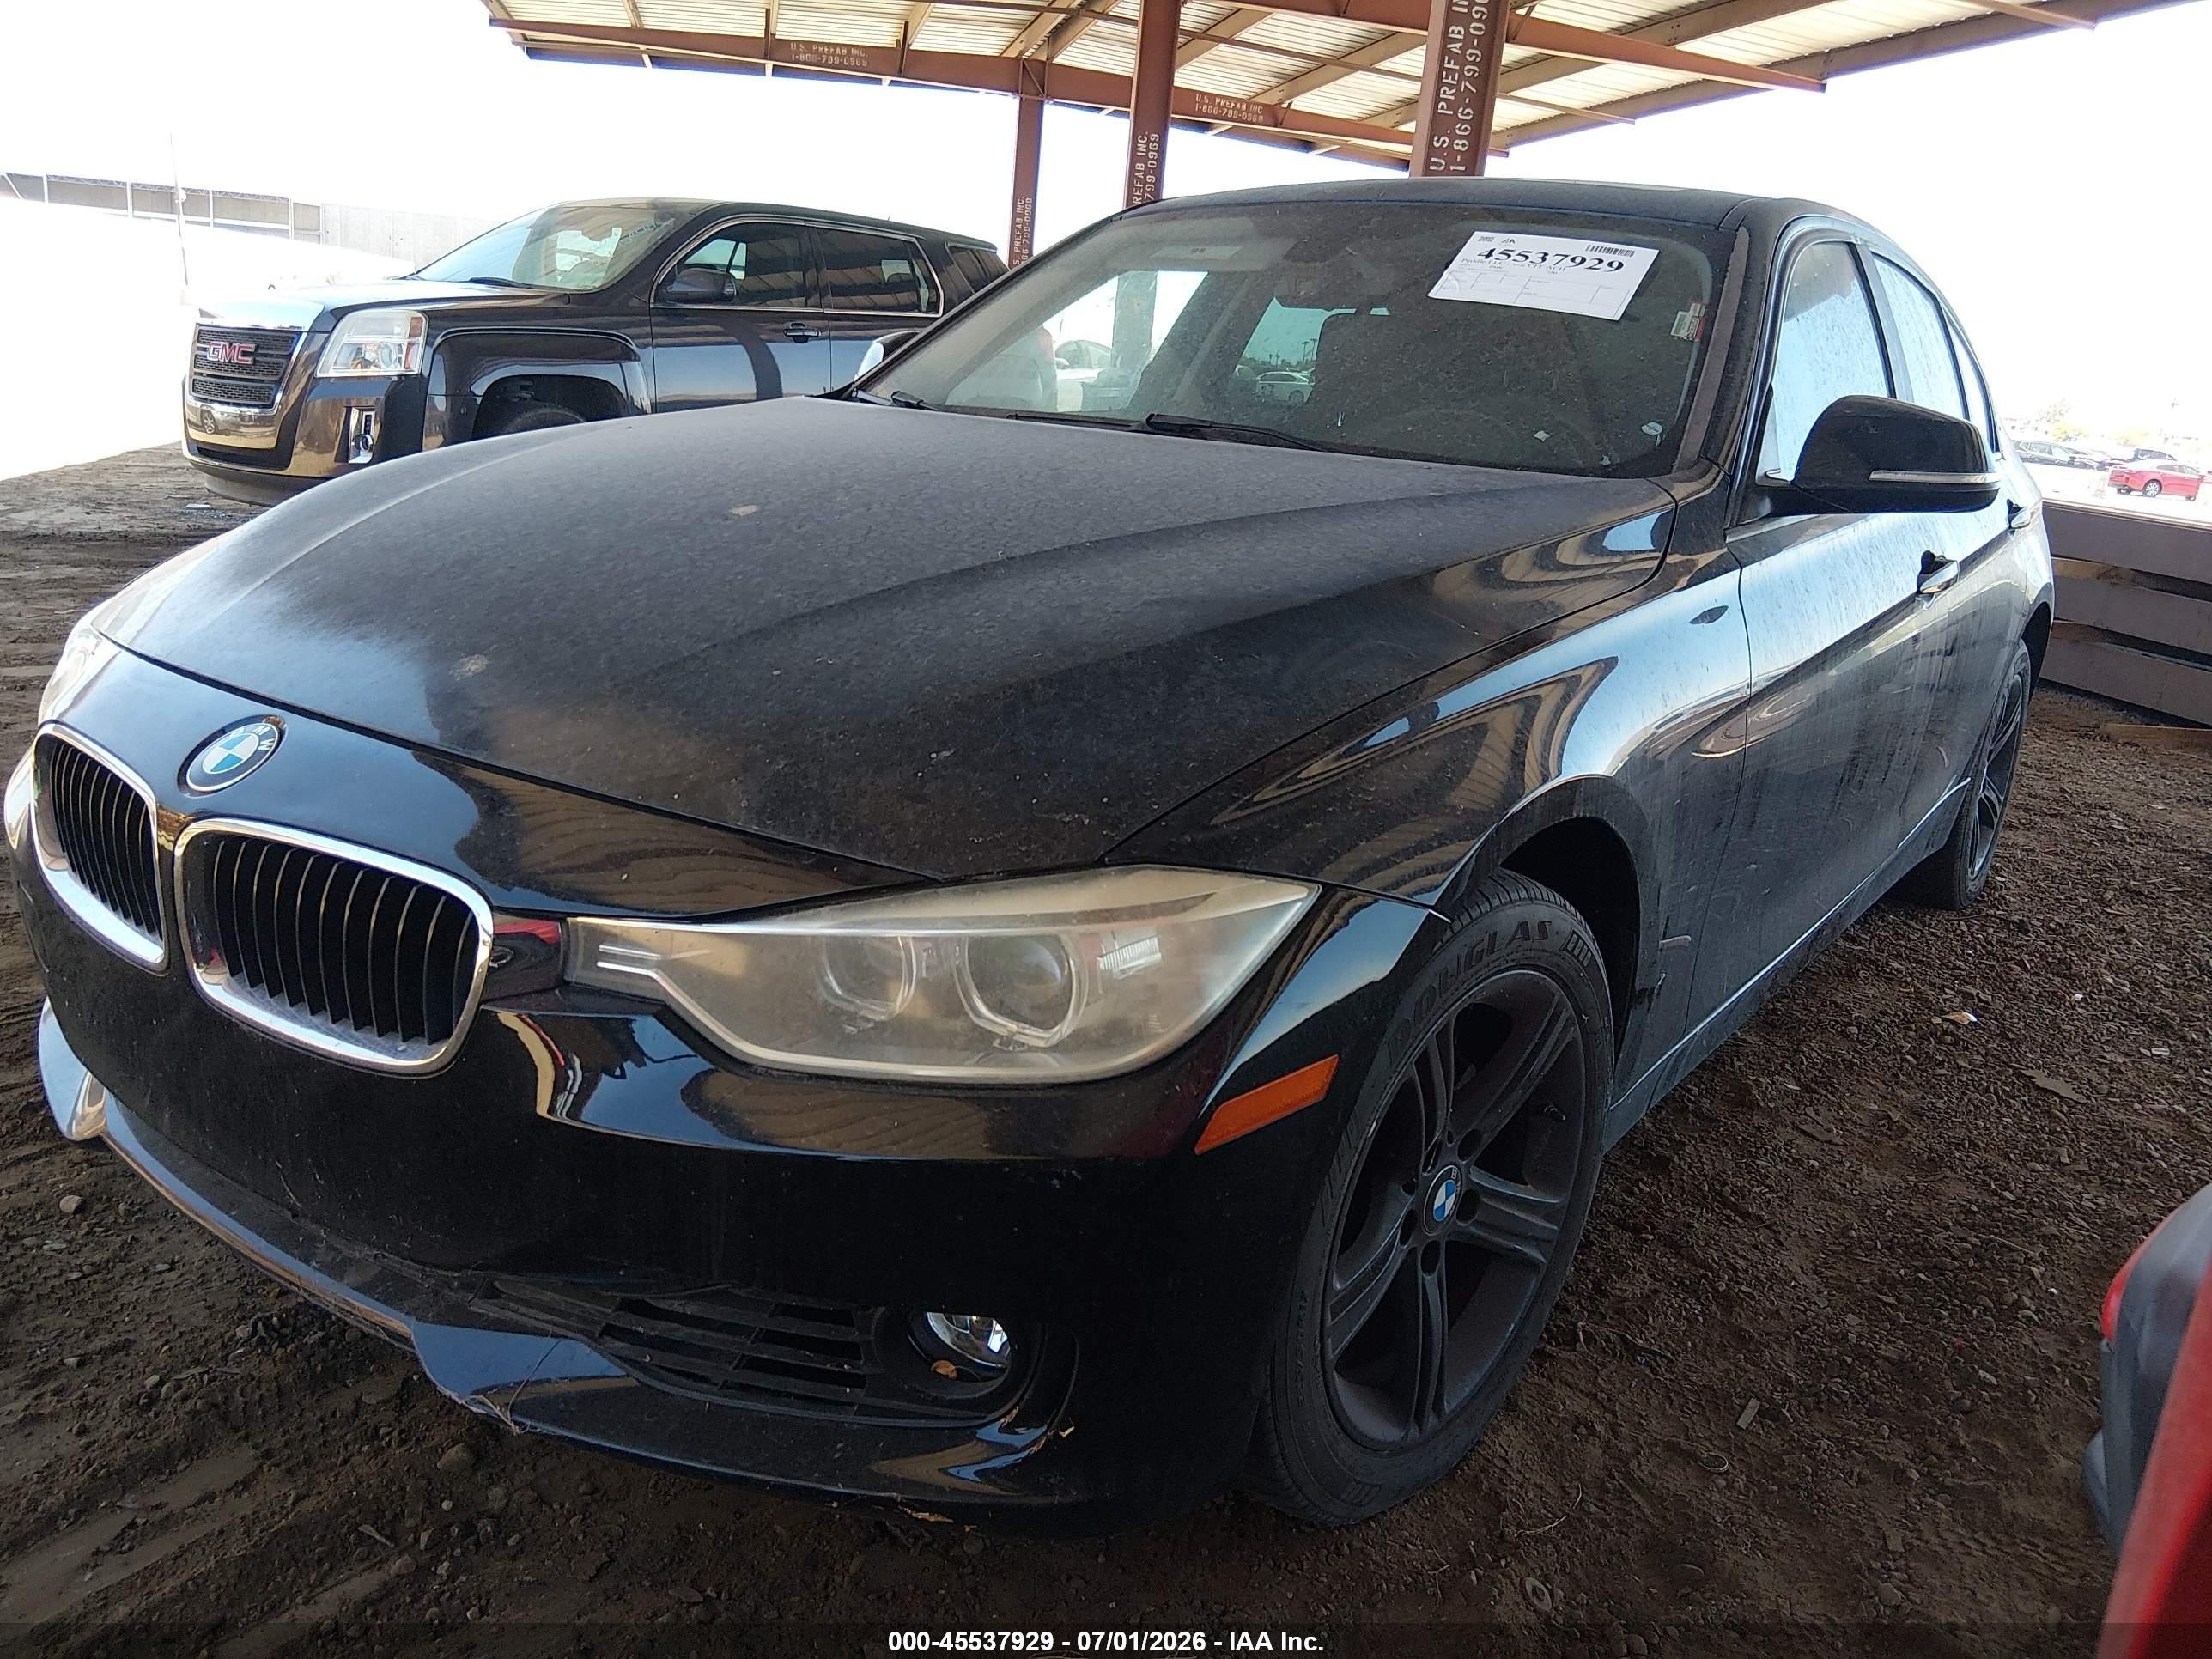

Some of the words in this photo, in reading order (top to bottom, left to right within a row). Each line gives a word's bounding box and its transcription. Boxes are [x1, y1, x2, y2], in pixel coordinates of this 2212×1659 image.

[812, 44, 848, 56] PREFAB
[1437, 25, 1465, 115] PREFAB
[1449, 0, 1490, 172] 1-866-799-09
[1215, 97, 1247, 111] PREFAB
[1136, 131, 1149, 156] INC.
[1429, 129, 1451, 172] U.S.
[1133, 162, 1146, 205] REFAB
[1144, 133, 1160, 201] 799-0969
[1013, 219, 1024, 252] PREFAB
[1477, 246, 1625, 273] 45537929
[207, 341, 256, 365] GMC
[228, 725, 276, 752] BMW
[1387, 919, 1553, 1066] DOUGLAS
